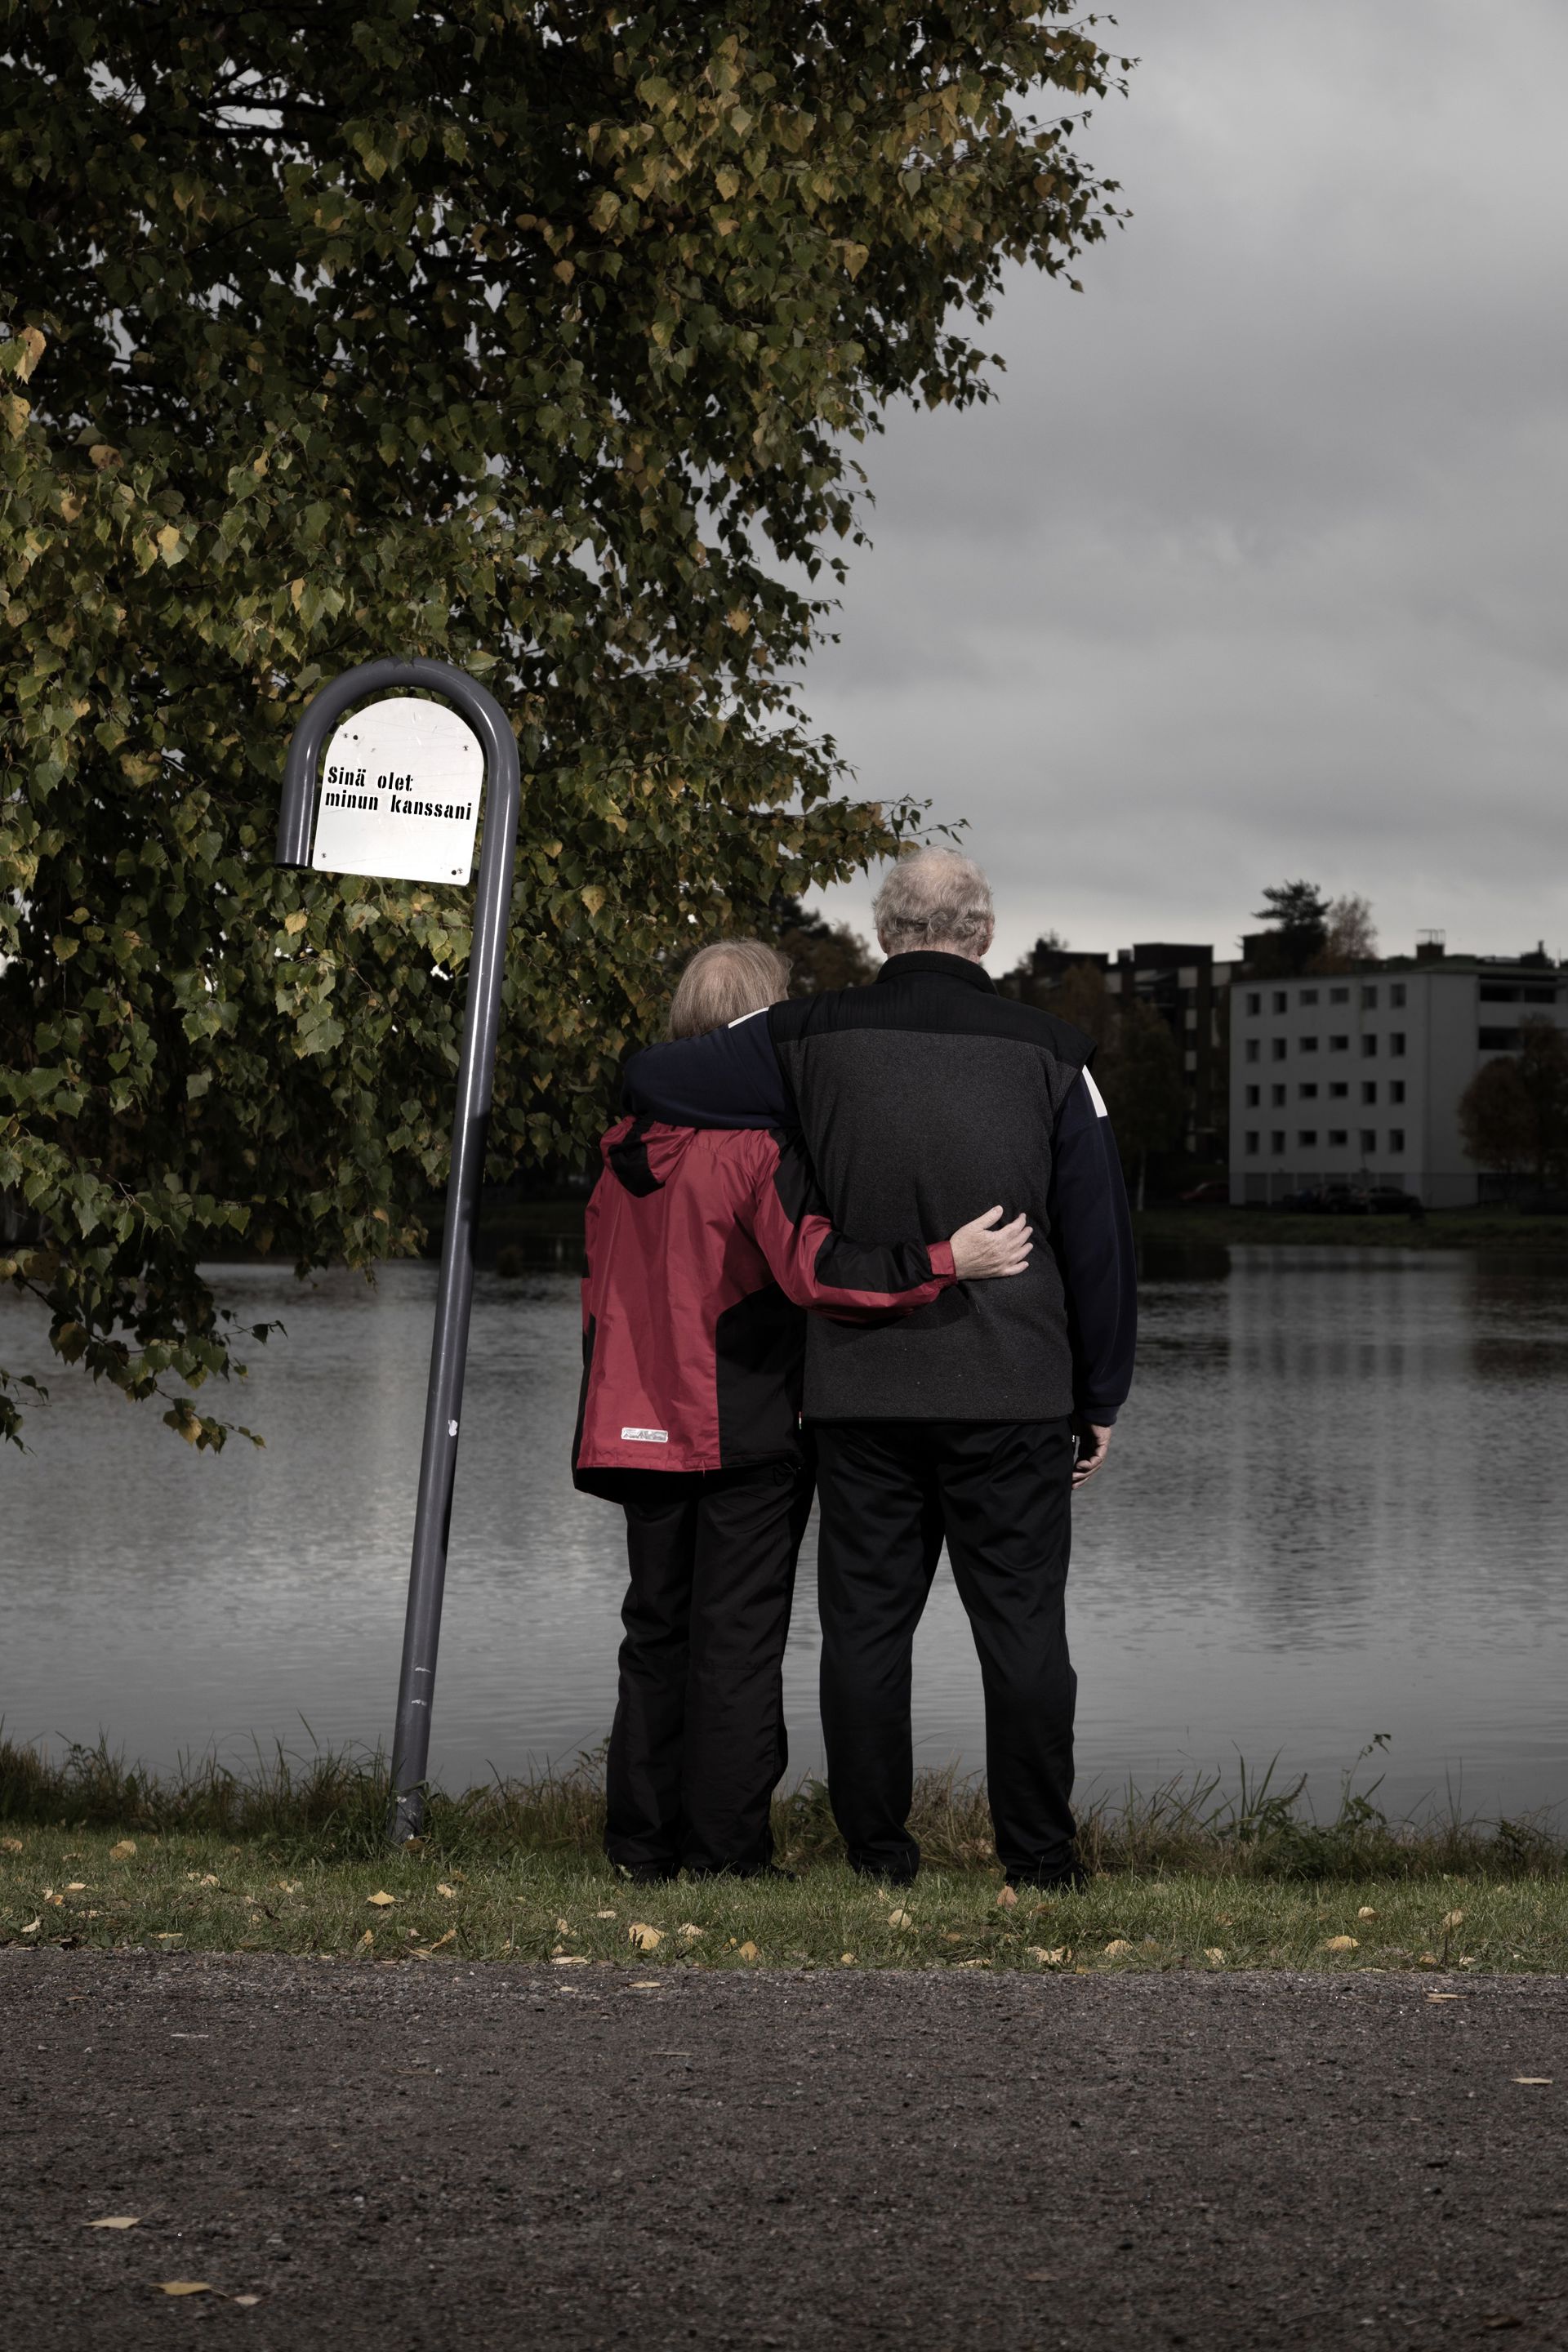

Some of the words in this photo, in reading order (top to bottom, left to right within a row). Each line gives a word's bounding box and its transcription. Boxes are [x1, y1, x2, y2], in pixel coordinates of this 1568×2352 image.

[327, 766, 367, 786] Sinä
[377, 772, 413, 791] olet
[325, 790, 378, 811] minun
[390, 795, 471, 820] kanssani
